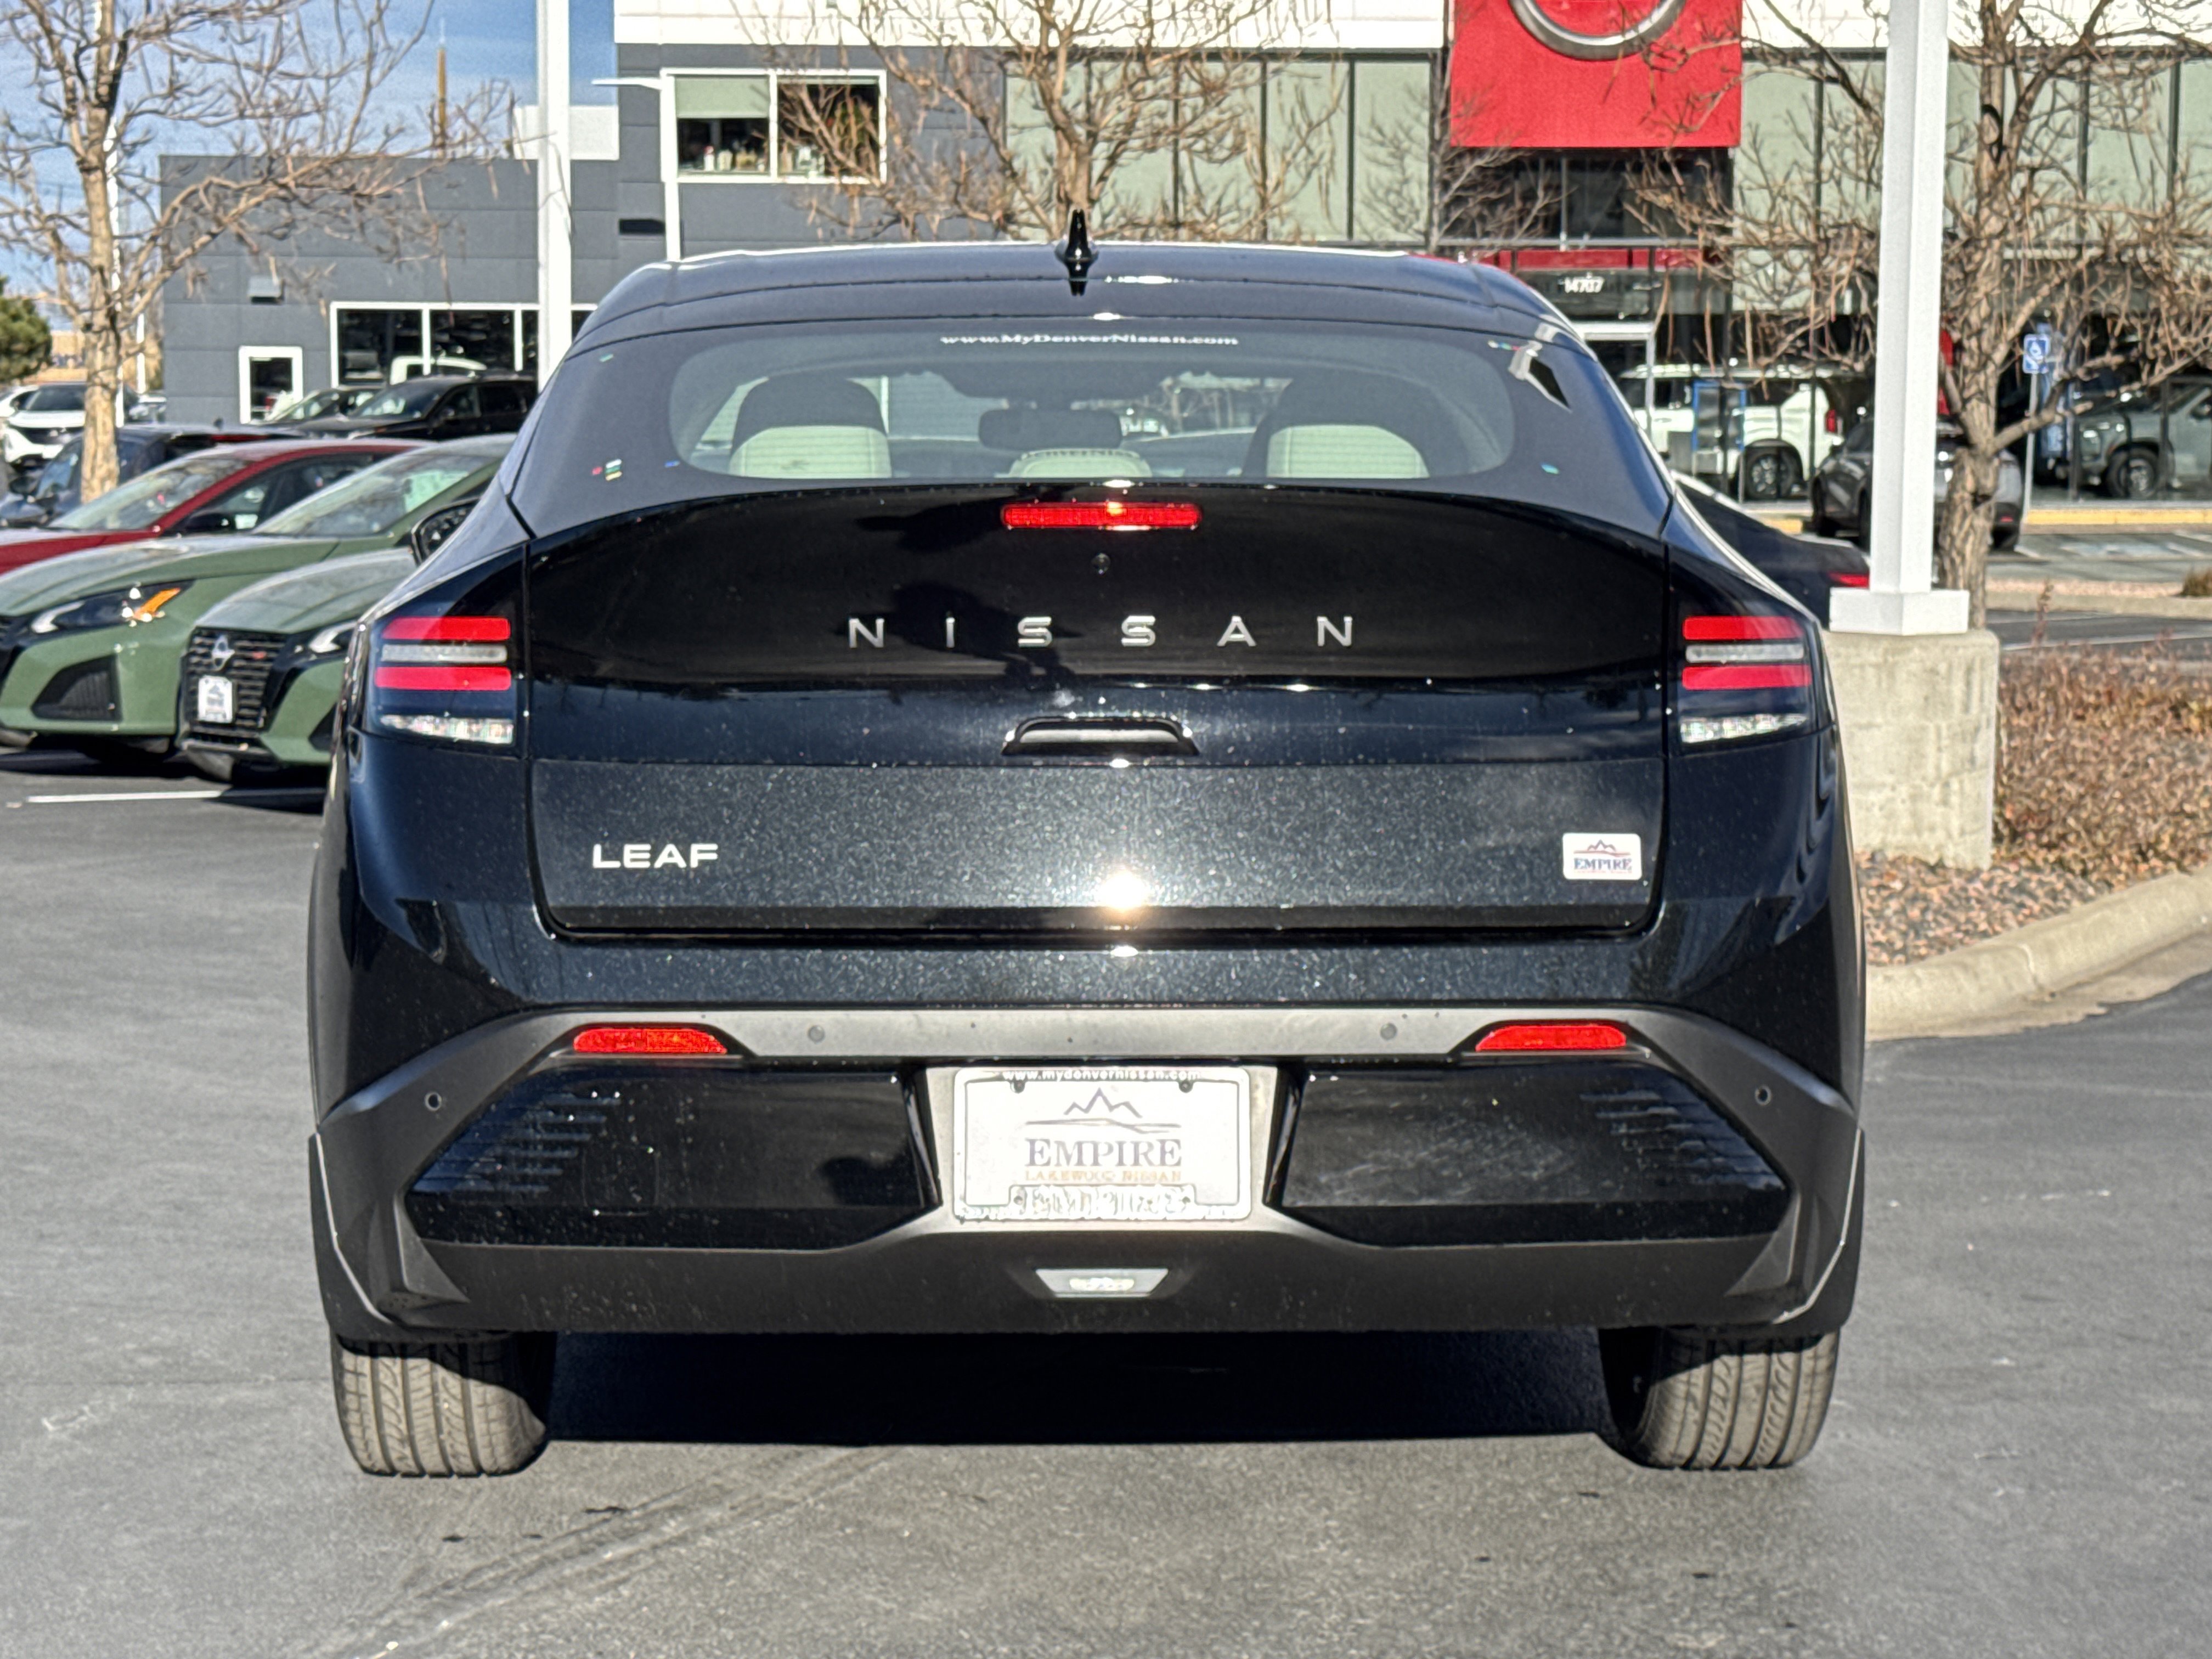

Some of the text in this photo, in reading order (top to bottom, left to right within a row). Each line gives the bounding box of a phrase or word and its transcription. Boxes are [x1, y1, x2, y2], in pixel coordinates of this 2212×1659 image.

[939, 333, 1239, 345] www.MyDenverNissan.com
[849, 615, 1353, 648] NISSAN
[592, 843, 719, 868] LEAF
[1573, 857, 1632, 870] EMPIRE
[1024, 1138, 1182, 1167] EMPIRE
